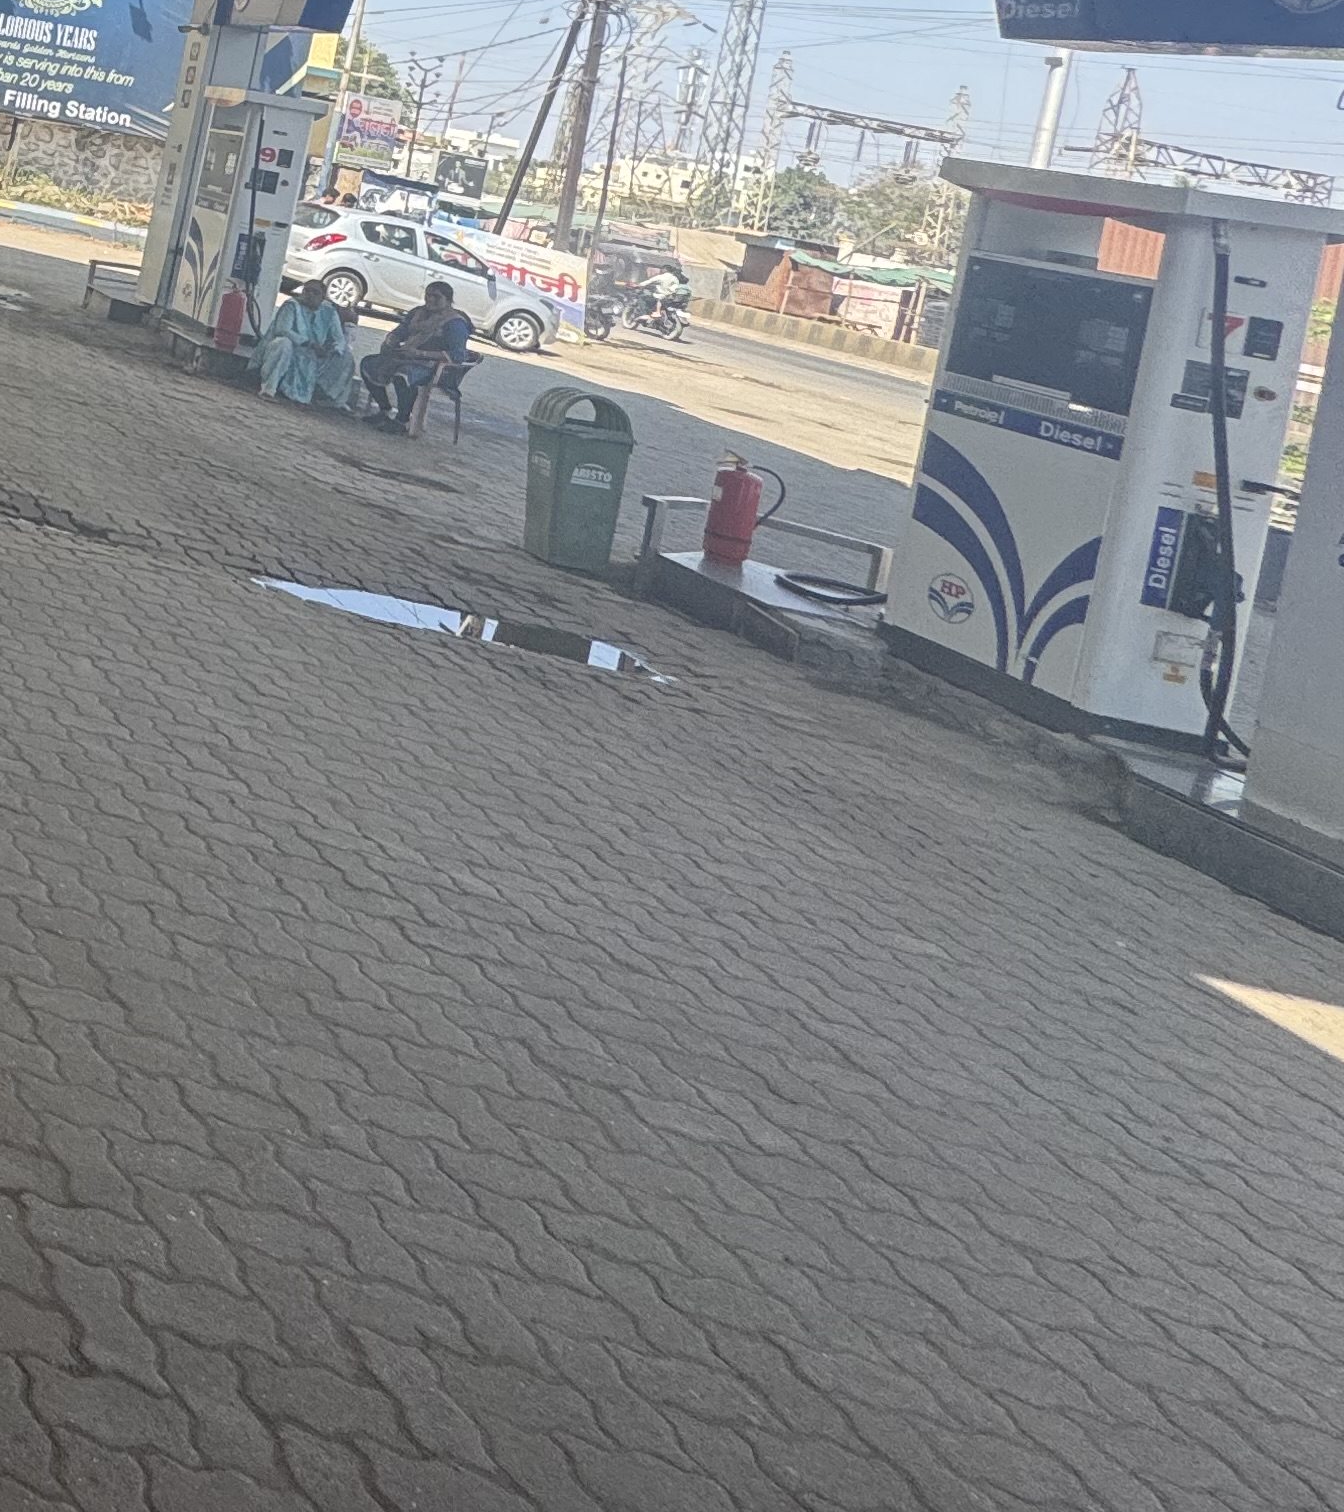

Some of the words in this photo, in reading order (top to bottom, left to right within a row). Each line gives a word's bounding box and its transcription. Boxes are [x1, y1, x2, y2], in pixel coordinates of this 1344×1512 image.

[55, 21, 98, 51] YEARS
[5, 51, 16, 67] is
[15, 57, 59, 76] serving
[60, 62, 83, 78] into
[83, 65, 106, 83] this
[107, 70, 135, 88] from
[19, 71, 40, 88] 20
[38, 76, 74, 94] years
[3, 89, 61, 119] Filling
[64, 100, 132, 129] Station
[1040, 419, 1102, 452] Diesel
[1148, 526, 1178, 590] Diesel
[940, 579, 966, 599] HP
